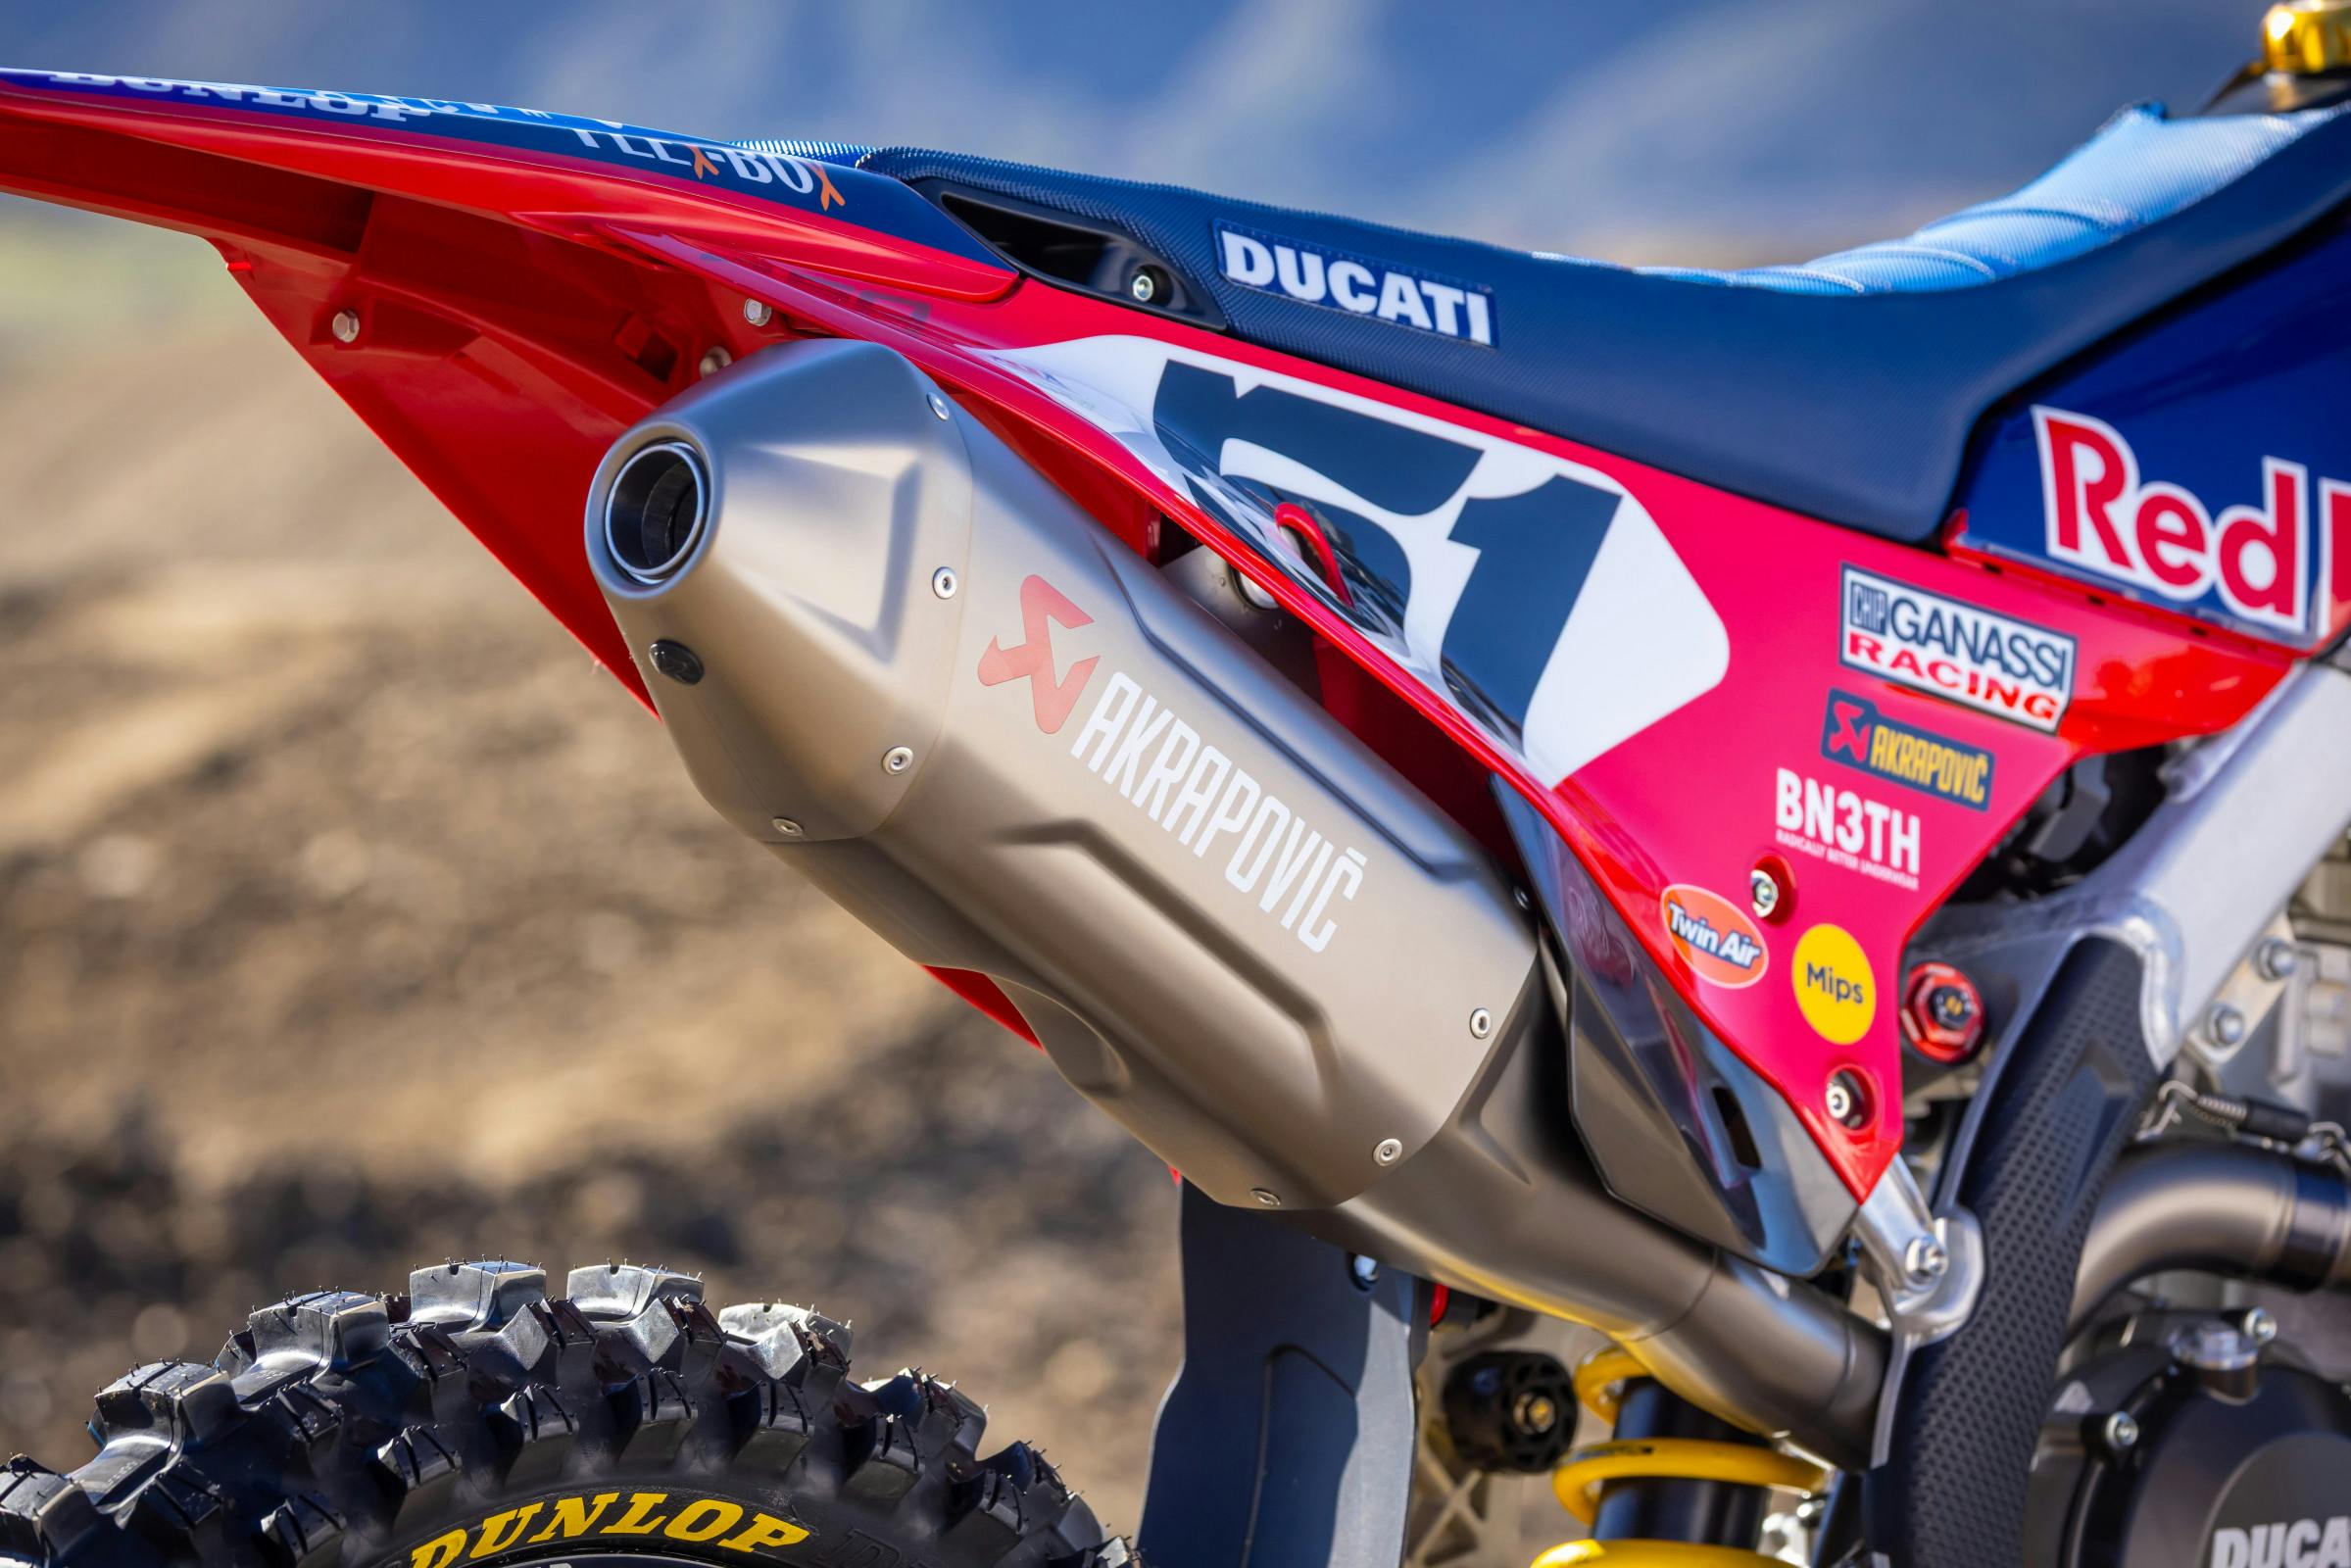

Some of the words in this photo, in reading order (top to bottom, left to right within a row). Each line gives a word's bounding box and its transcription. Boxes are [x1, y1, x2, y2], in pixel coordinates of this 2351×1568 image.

[1221, 230, 1492, 346] DUCATI
[2032, 404, 2307, 635] Red
[1848, 631, 2059, 721] RACING
[1850, 581, 1887, 636] CHIP
[1891, 597, 2067, 692] GANASSI
[1069, 670, 1368, 954] AKRAPOVIČ
[1776, 767, 1921, 875] BN3TH
[1668, 901, 1721, 955] Twin
[1717, 929, 1763, 969] Air
[1806, 961, 1864, 1004] Mips
[409, 1492, 809, 1568] DUNLOP
